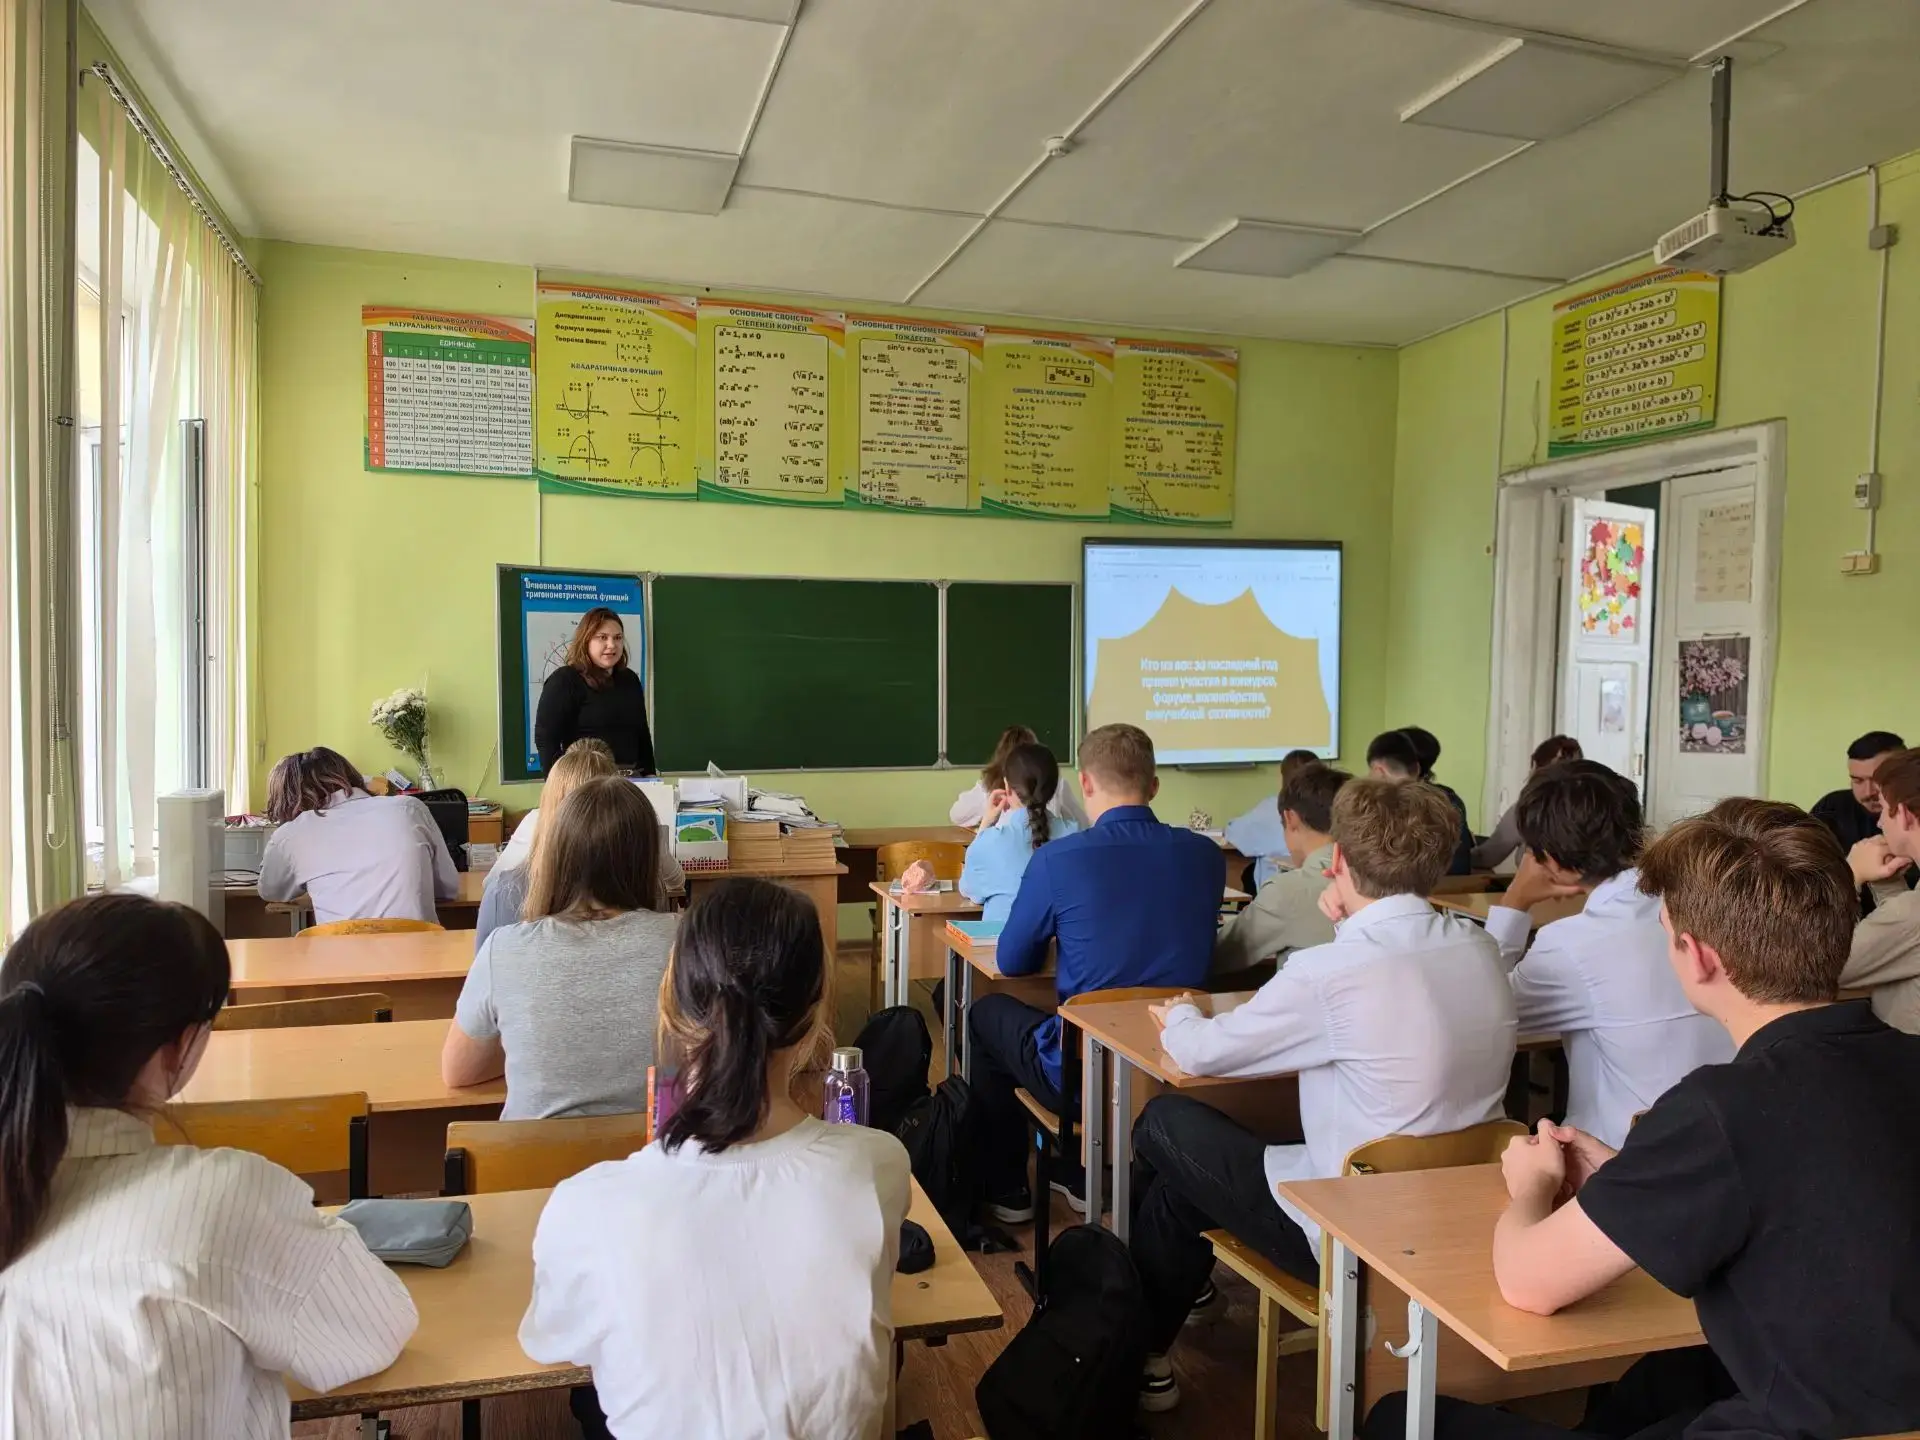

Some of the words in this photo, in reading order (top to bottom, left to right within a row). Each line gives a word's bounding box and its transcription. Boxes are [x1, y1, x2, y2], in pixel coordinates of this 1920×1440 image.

[571, 292, 618, 301] КВАДРАТНОЕ
[730, 308, 773, 318] ОСНОВНЫЕ
[389, 321, 442, 330] НАТУРАЛЬНЫХ
[852, 320, 894, 330] ОСНОВНЫЕ
[439, 339, 476, 348] ЕДИНИЦЫ
[895, 334, 936, 343] ТОЖДЕСТВА
[525, 580, 563, 590] Основные
[526, 592, 598, 601] тригонометрических
[600, 593, 628, 602] функций
[1141, 658, 1158, 671] Кто
